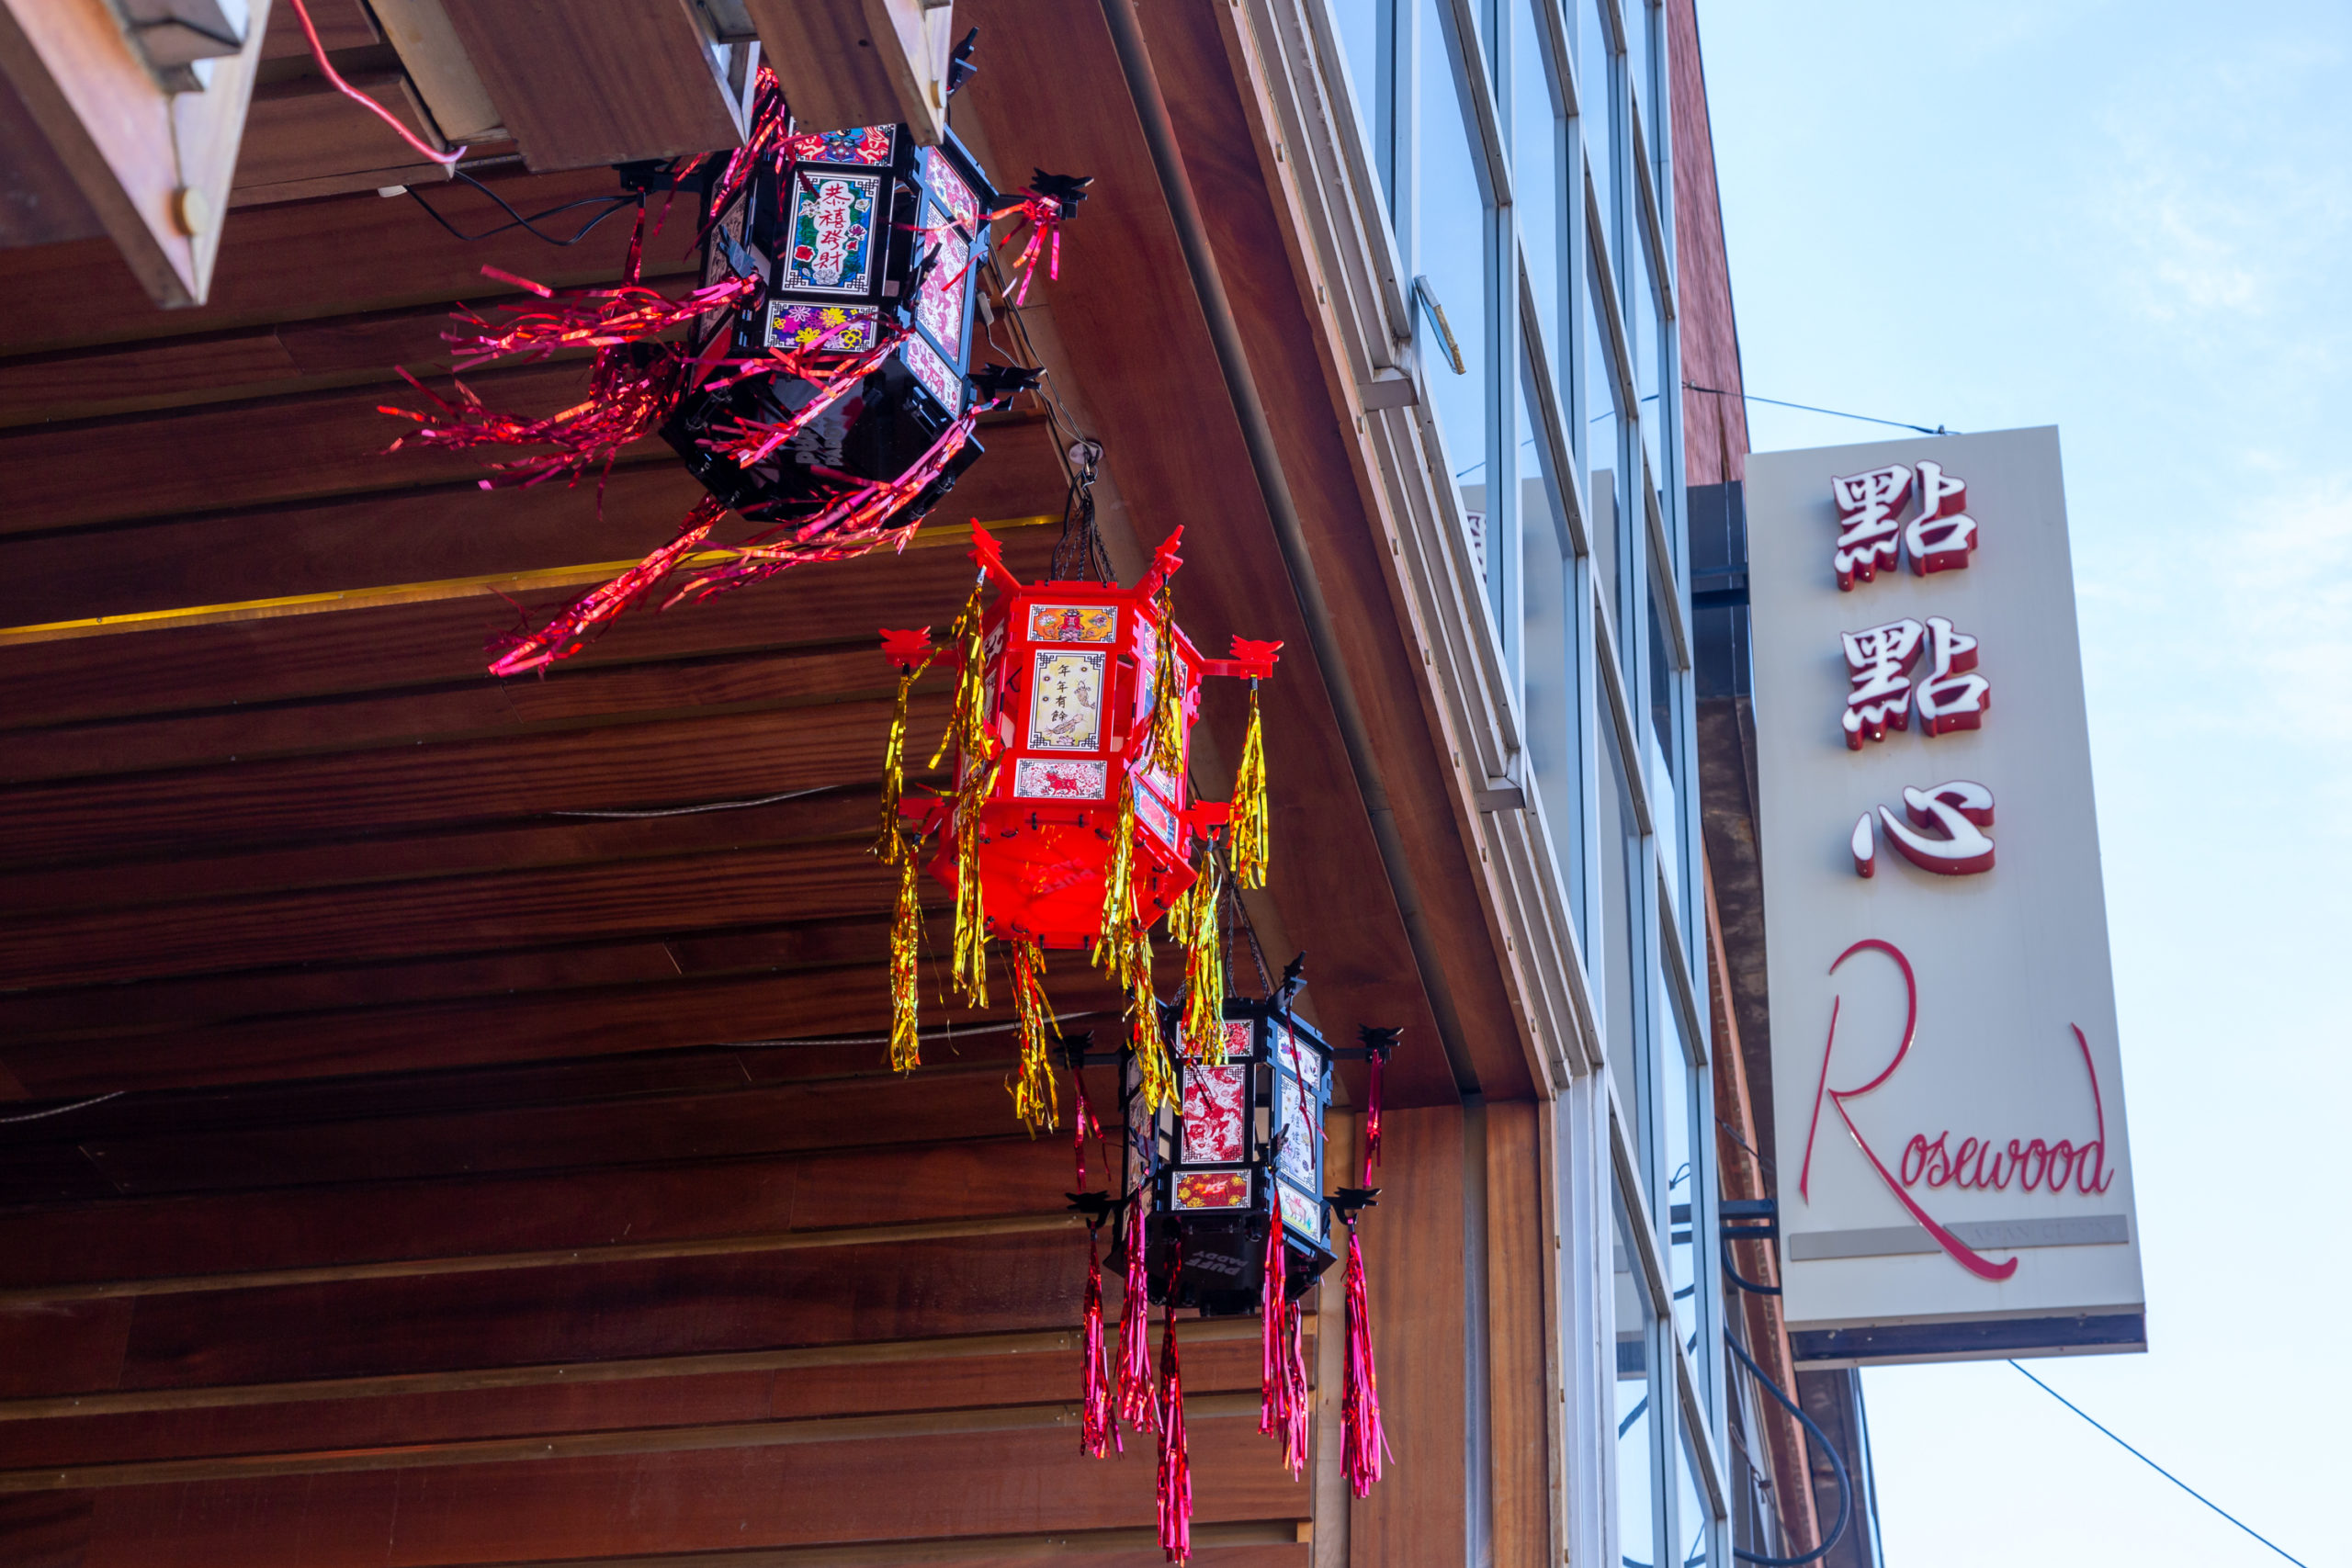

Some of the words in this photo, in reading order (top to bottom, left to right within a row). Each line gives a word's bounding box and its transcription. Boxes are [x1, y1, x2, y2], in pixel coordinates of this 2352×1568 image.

[1832, 460, 1996, 879] 點點心
[1800, 939, 2114, 1282] Rosewood
